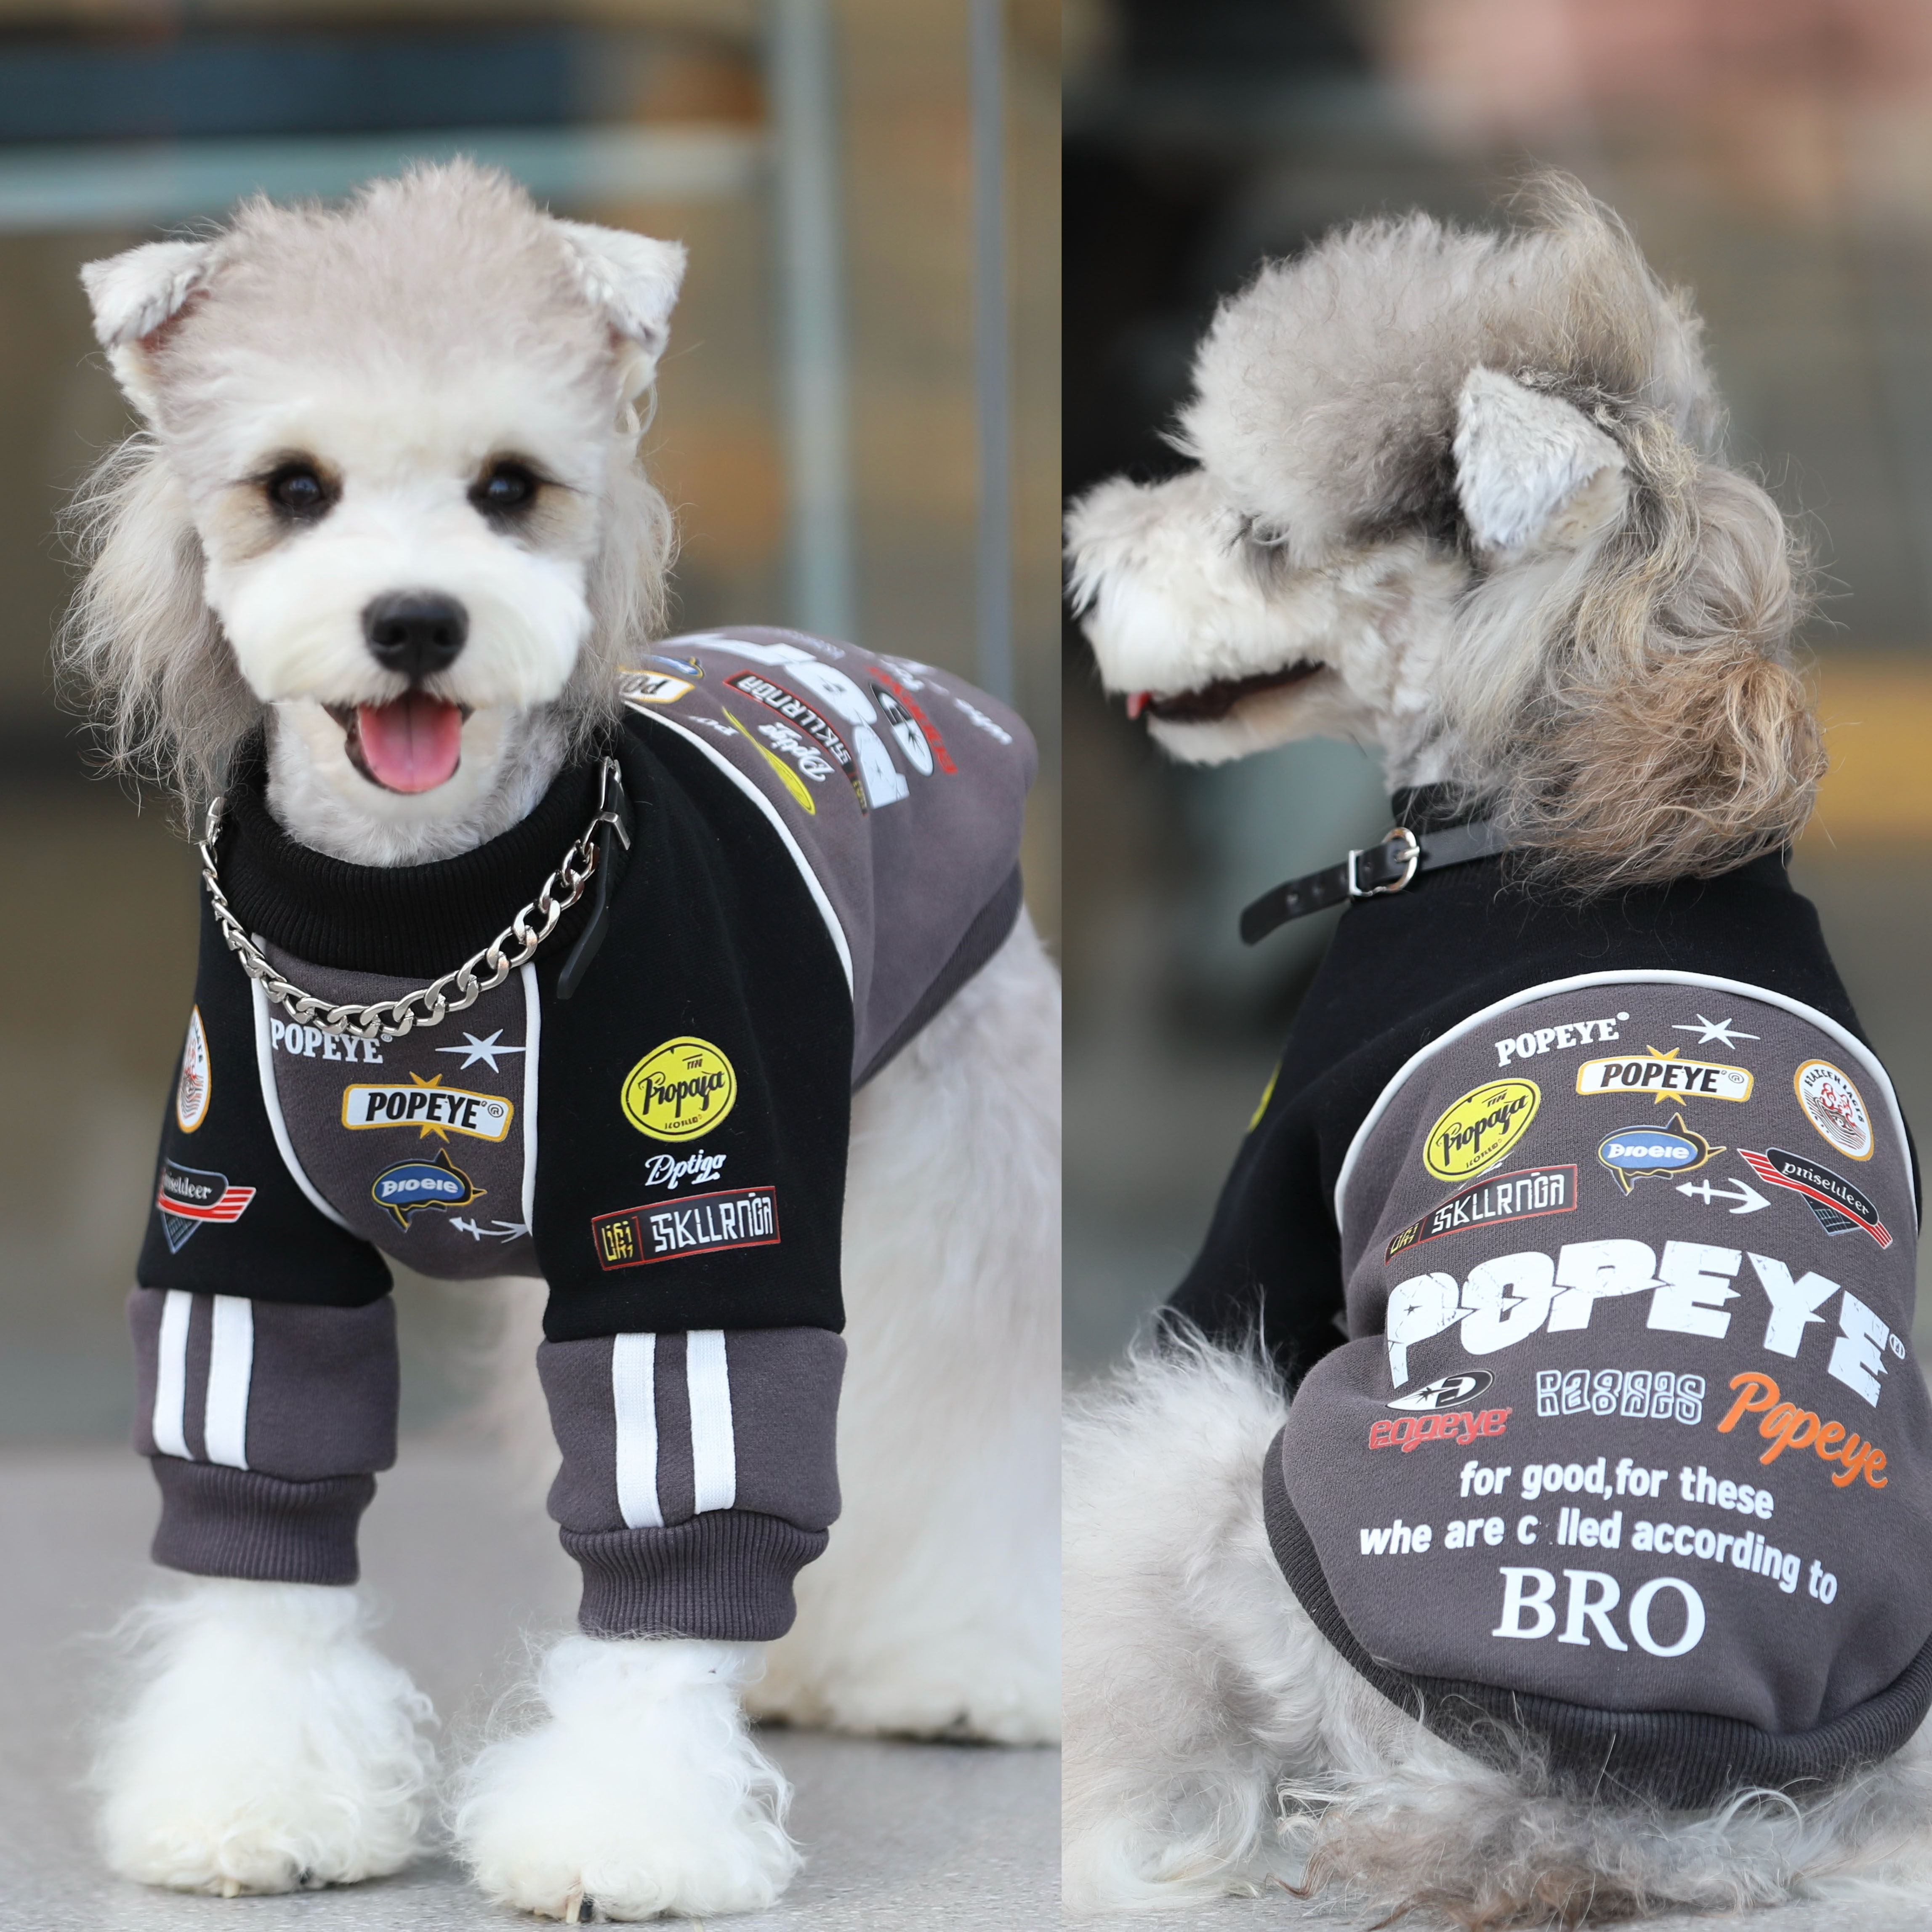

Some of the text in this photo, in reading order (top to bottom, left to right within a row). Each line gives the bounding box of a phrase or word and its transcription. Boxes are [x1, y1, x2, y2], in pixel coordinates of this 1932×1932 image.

[1460, 1461, 1512, 1498] for
[1679, 1466, 1775, 1520] these
[1359, 1519, 1432, 1556] whe
[1444, 1515, 1504, 1550] are
[1631, 1521, 1801, 1594] according
[1809, 1559, 1838, 1605] to
[1492, 1566, 1706, 1658] BRO
